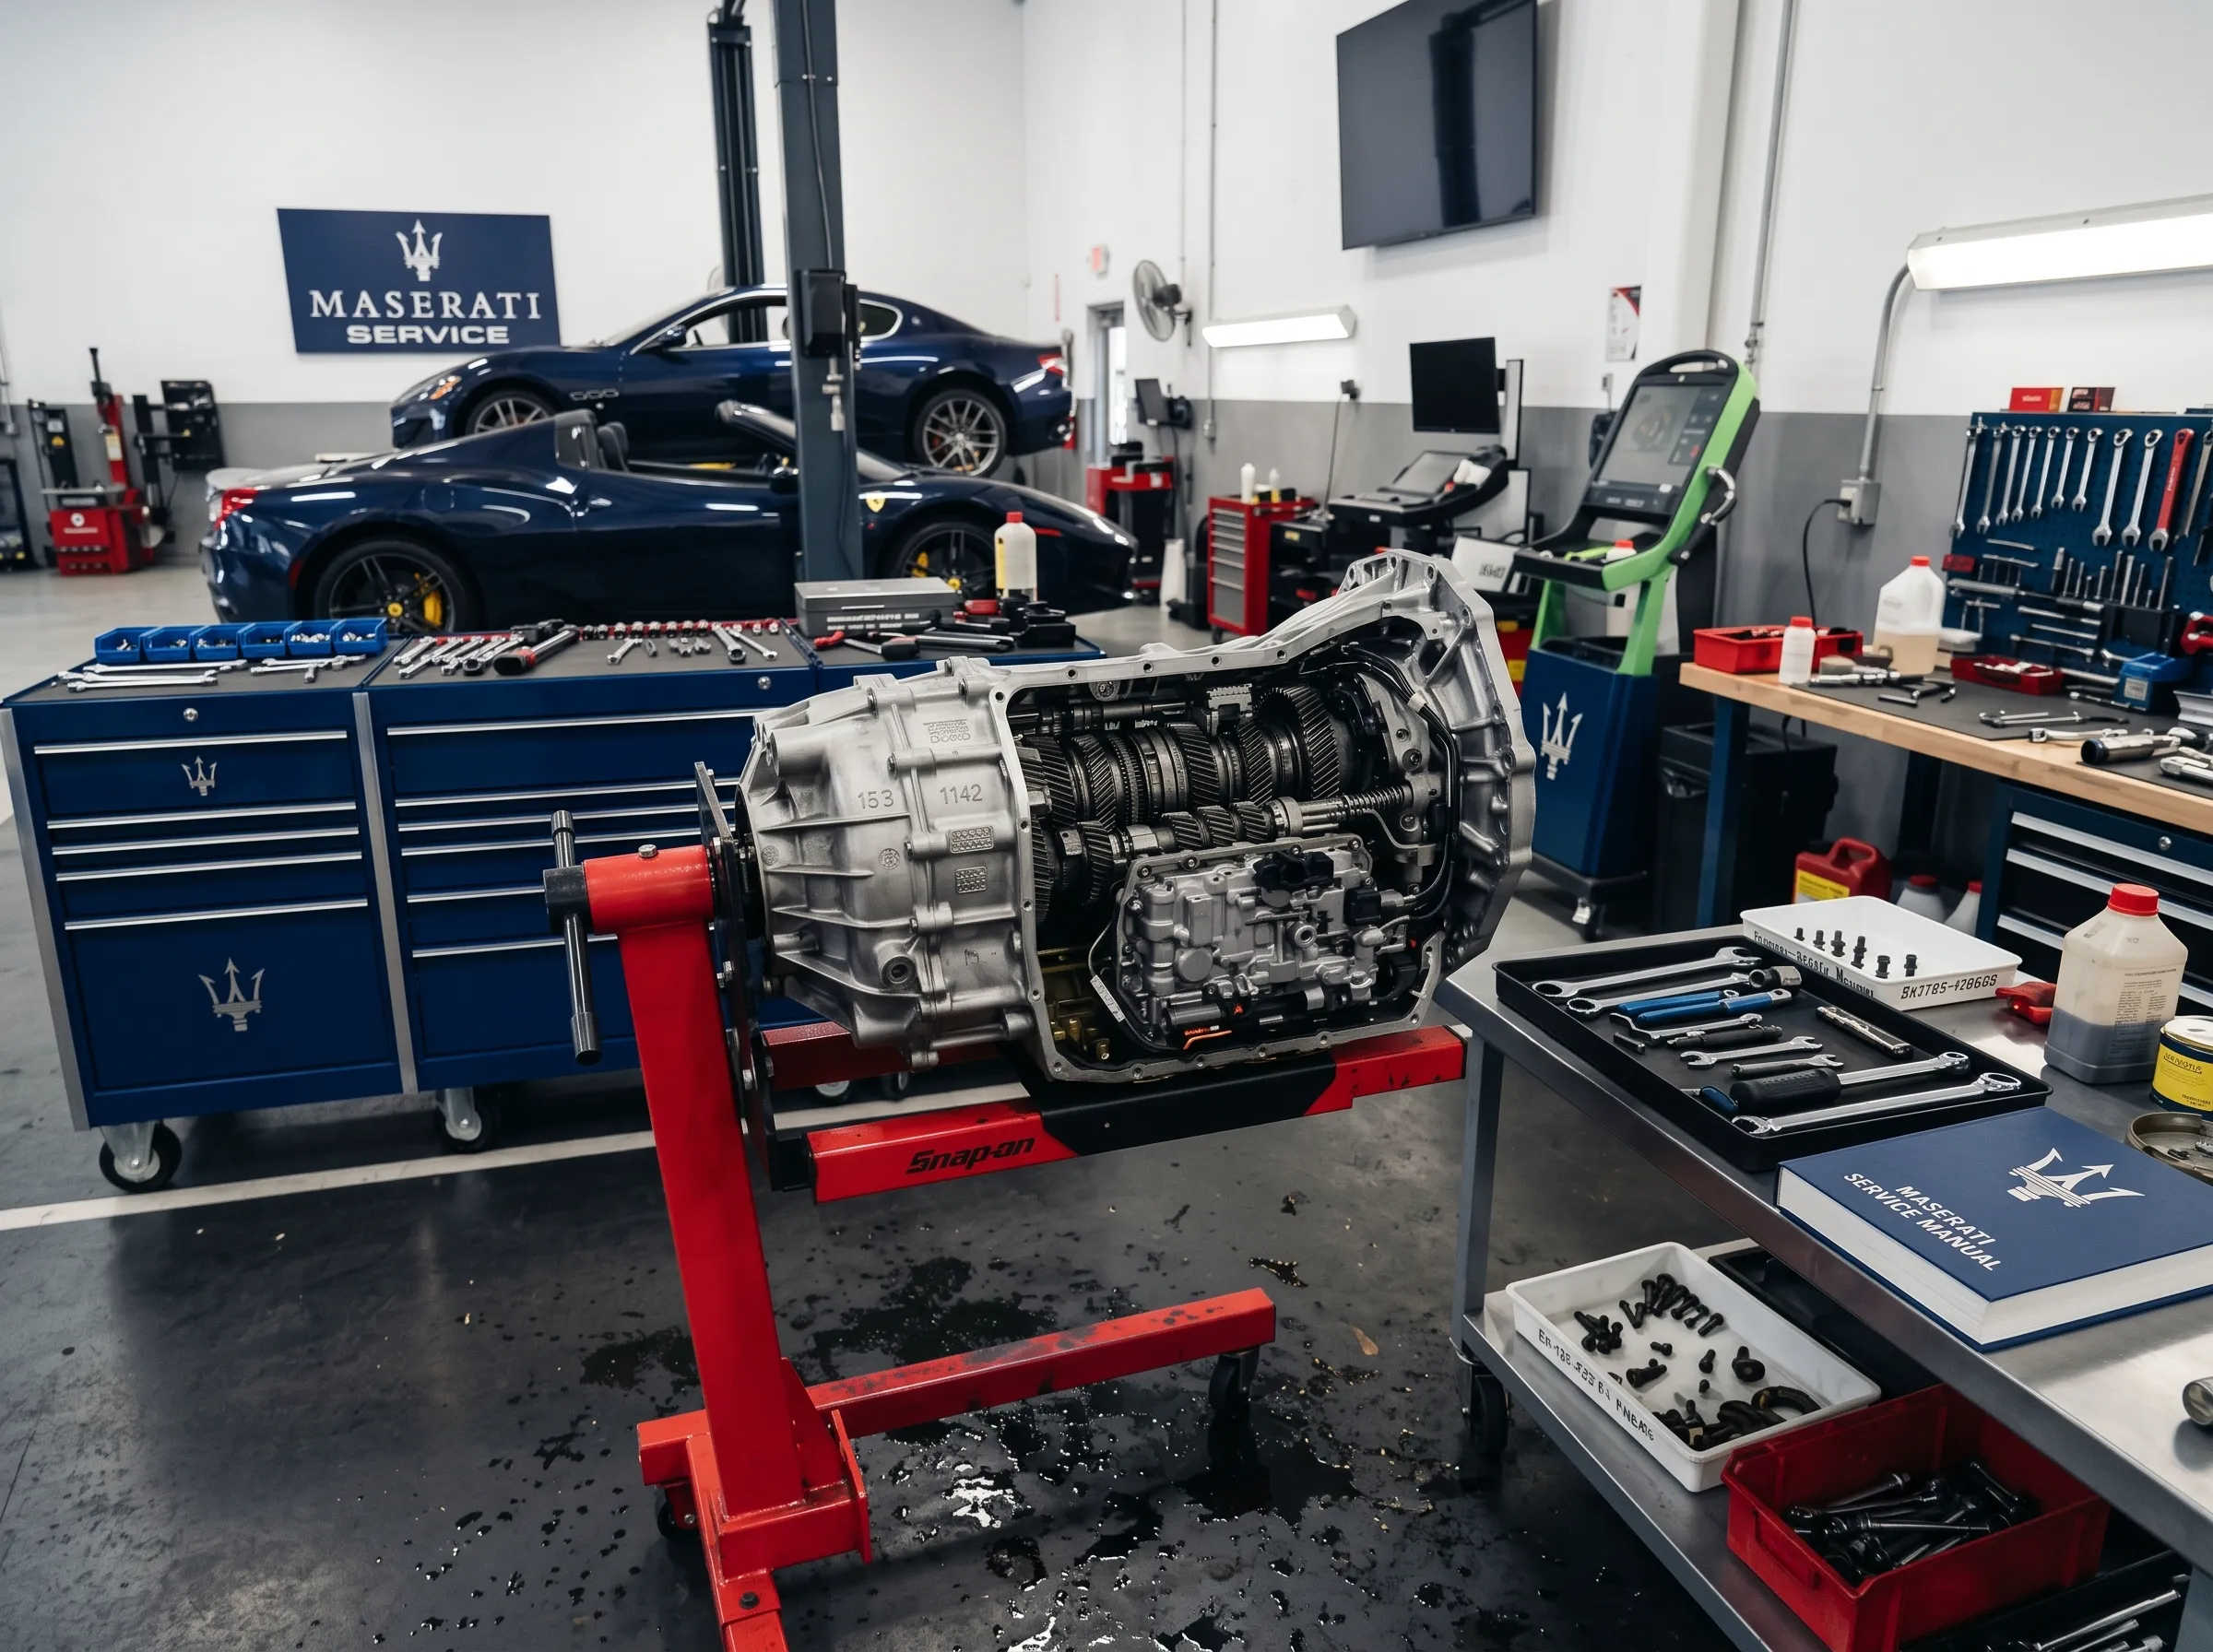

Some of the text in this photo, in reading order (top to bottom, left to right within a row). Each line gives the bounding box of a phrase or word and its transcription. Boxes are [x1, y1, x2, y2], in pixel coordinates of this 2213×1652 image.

[309, 289, 541, 319] MASERATI
[346, 324, 510, 345] SERVICE
[858, 789, 894, 809] 153
[940, 784, 983, 805] 1142
[905, 1137, 1036, 1174] Snap-on
[1844, 1173, 2002, 1271] SERVICE MANUAL
[1895, 1186, 1996, 1245] MASERATI
